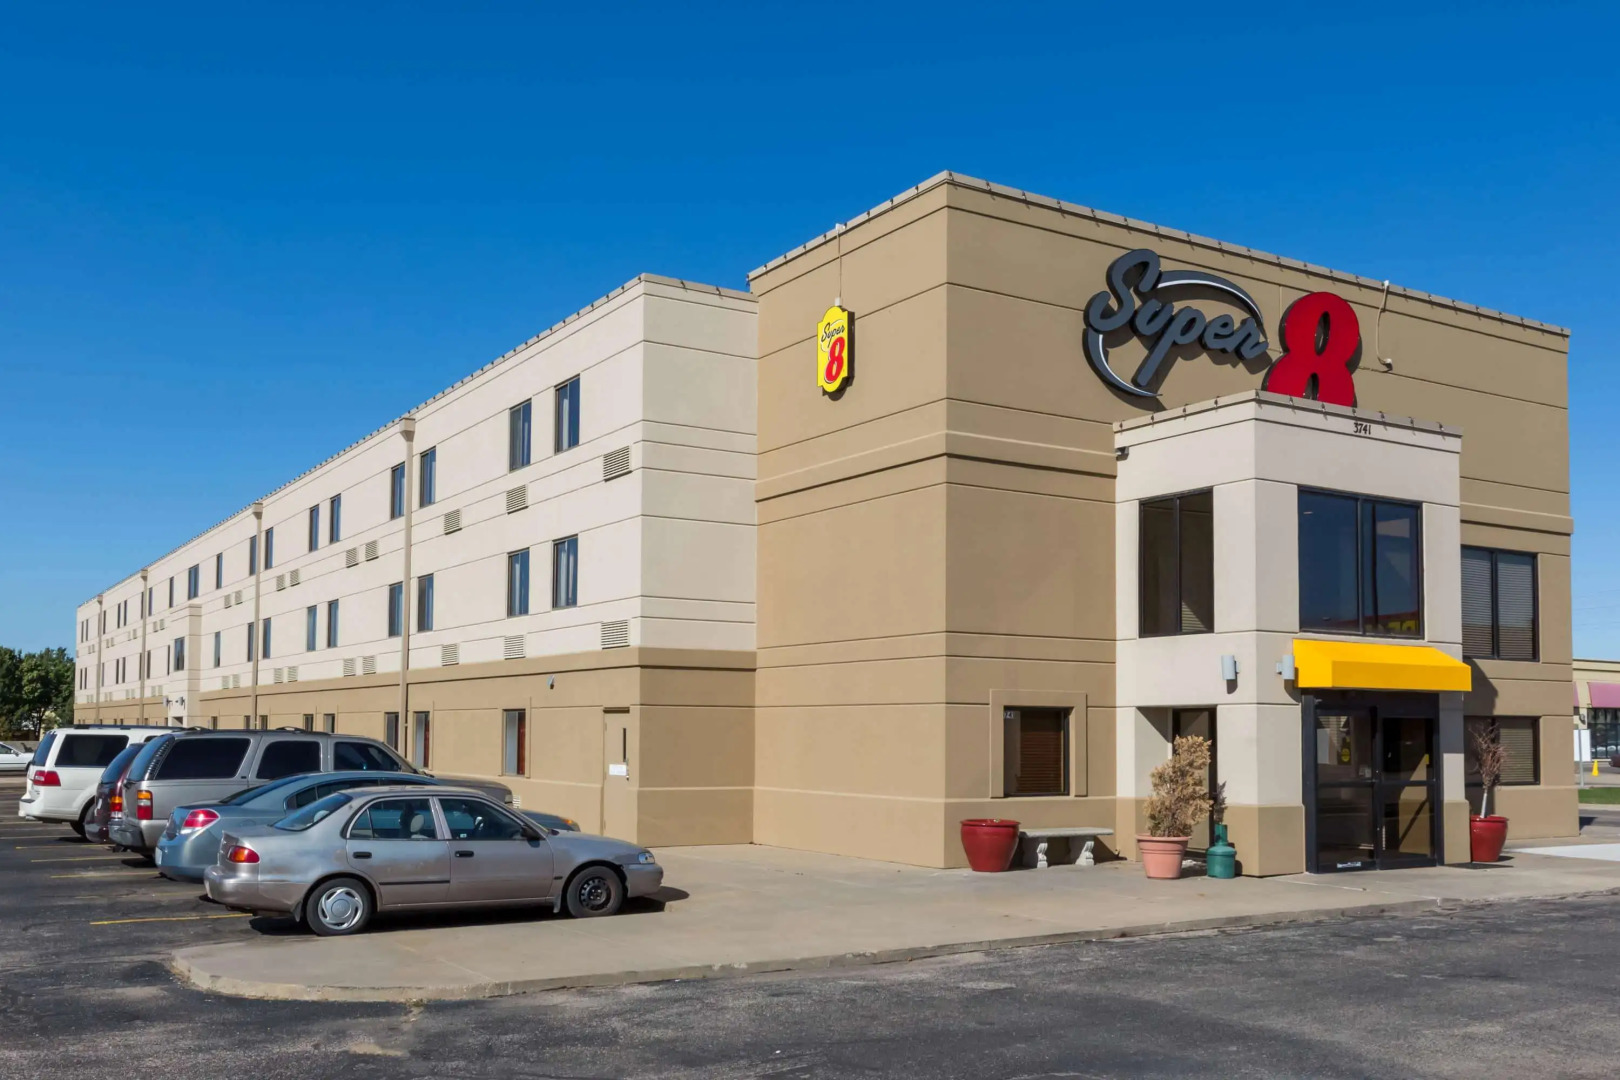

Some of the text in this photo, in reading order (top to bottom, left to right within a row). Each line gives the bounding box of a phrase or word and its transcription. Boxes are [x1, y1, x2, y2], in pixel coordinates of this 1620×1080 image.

[821, 322, 845, 348] Super
[1084, 249, 1360, 408] Super 8
[824, 337, 846, 384] 8
[1353, 422, 1371, 435] 3741
